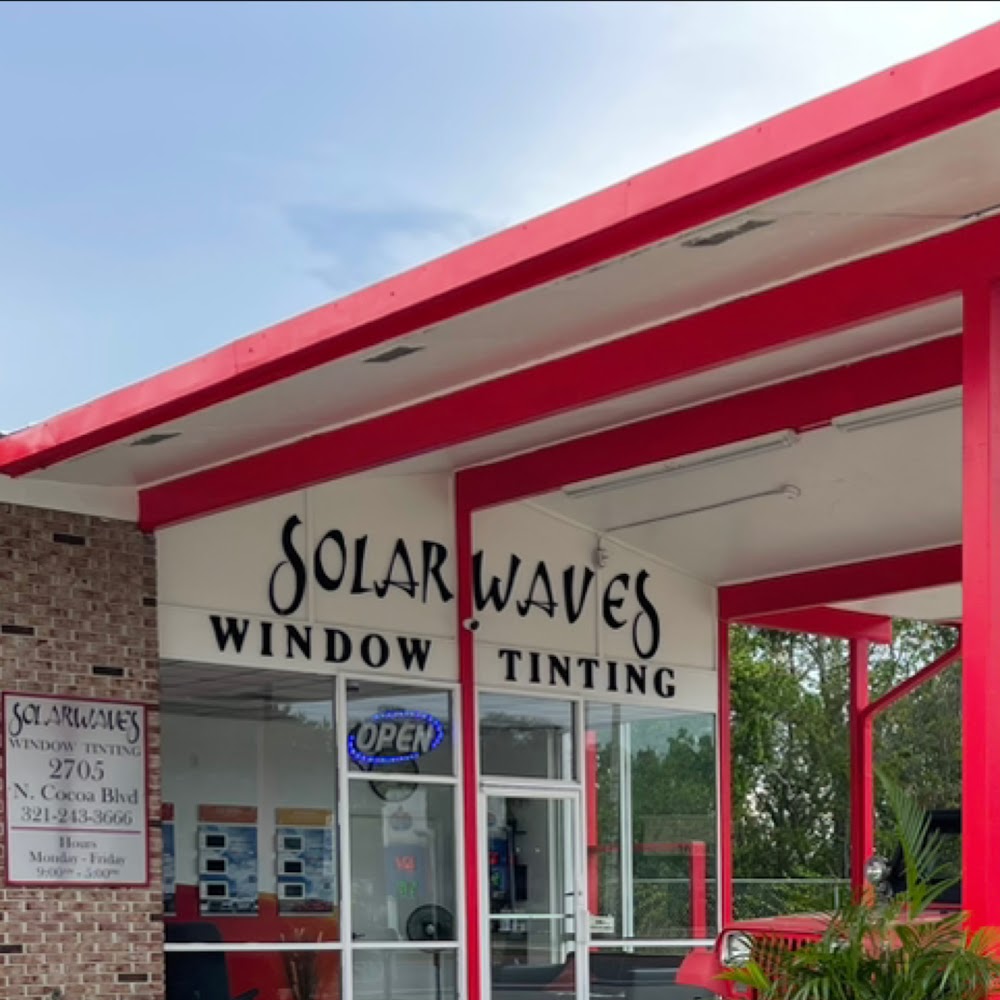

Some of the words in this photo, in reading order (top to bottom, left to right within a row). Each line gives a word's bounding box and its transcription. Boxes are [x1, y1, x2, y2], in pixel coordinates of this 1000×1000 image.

[210, 615, 432, 672] WINDOW
[499, 649, 677, 699] TINTING
[9, 737, 74, 752] WINDOW
[84, 743, 142, 757] TINTING
[355, 722, 435, 754] OPEN
[49, 758, 105, 781] 2705
[13, 782, 35, 800] N.
[40, 783, 96, 803] Cocoa
[101, 787, 139, 805] Blvd
[20, 806, 134, 826] 321-243-3666
[59, 836, 98, 849] Hours
[29, 851, 77, 864] Monday
[89, 852, 126, 866] Friday
